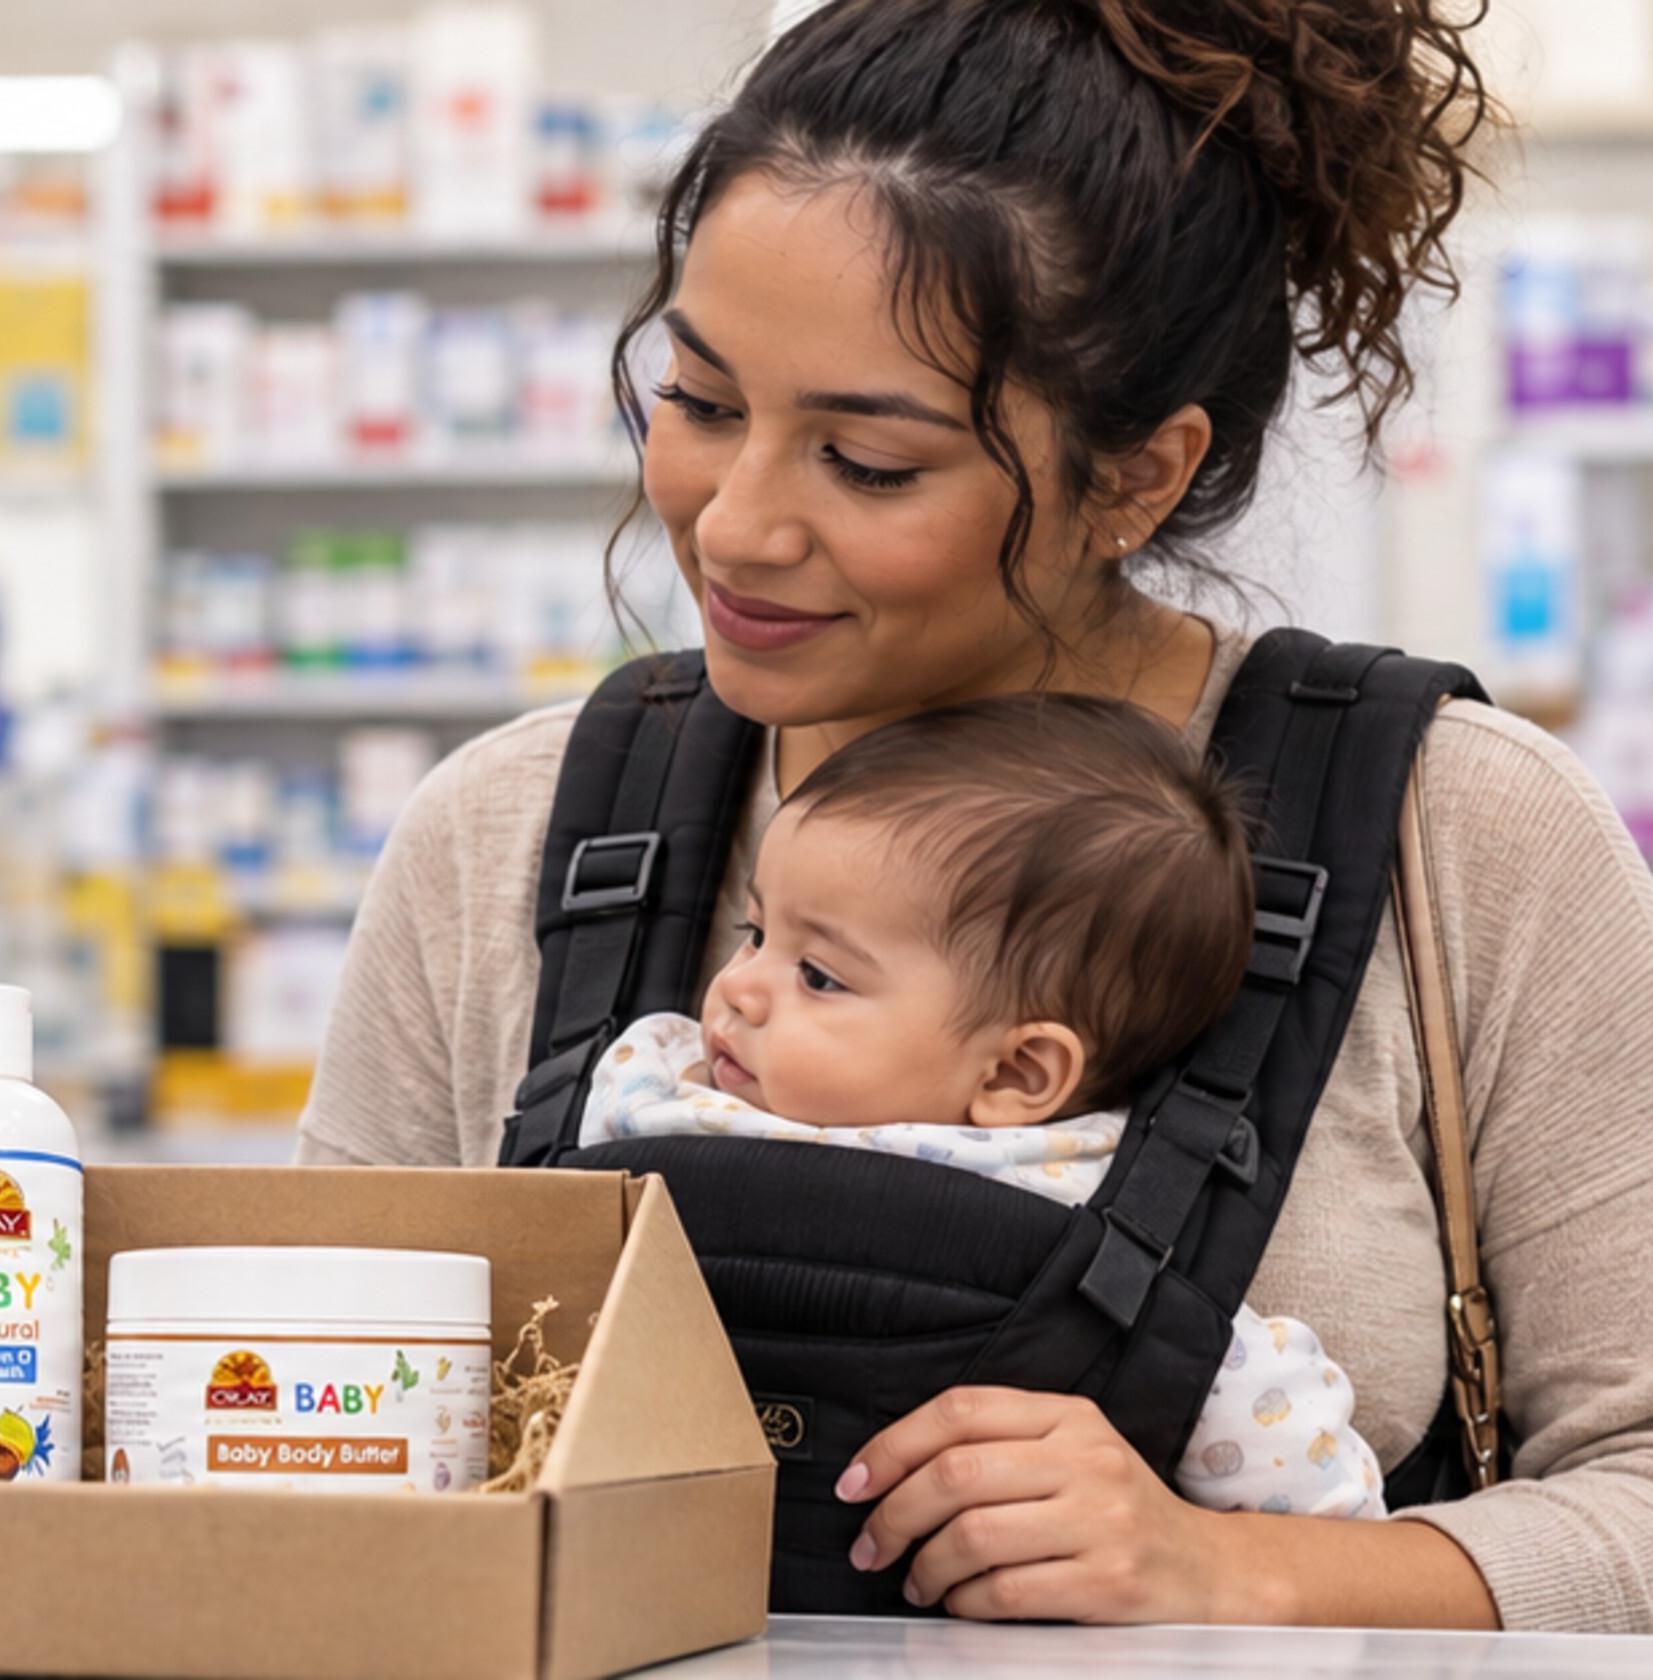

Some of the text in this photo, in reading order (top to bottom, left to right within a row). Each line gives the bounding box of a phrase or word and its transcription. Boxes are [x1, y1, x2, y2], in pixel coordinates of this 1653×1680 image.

[295, 1384, 384, 1415] BABY
[217, 1444, 272, 1466] Baby
[278, 1444, 336, 1466] Body
